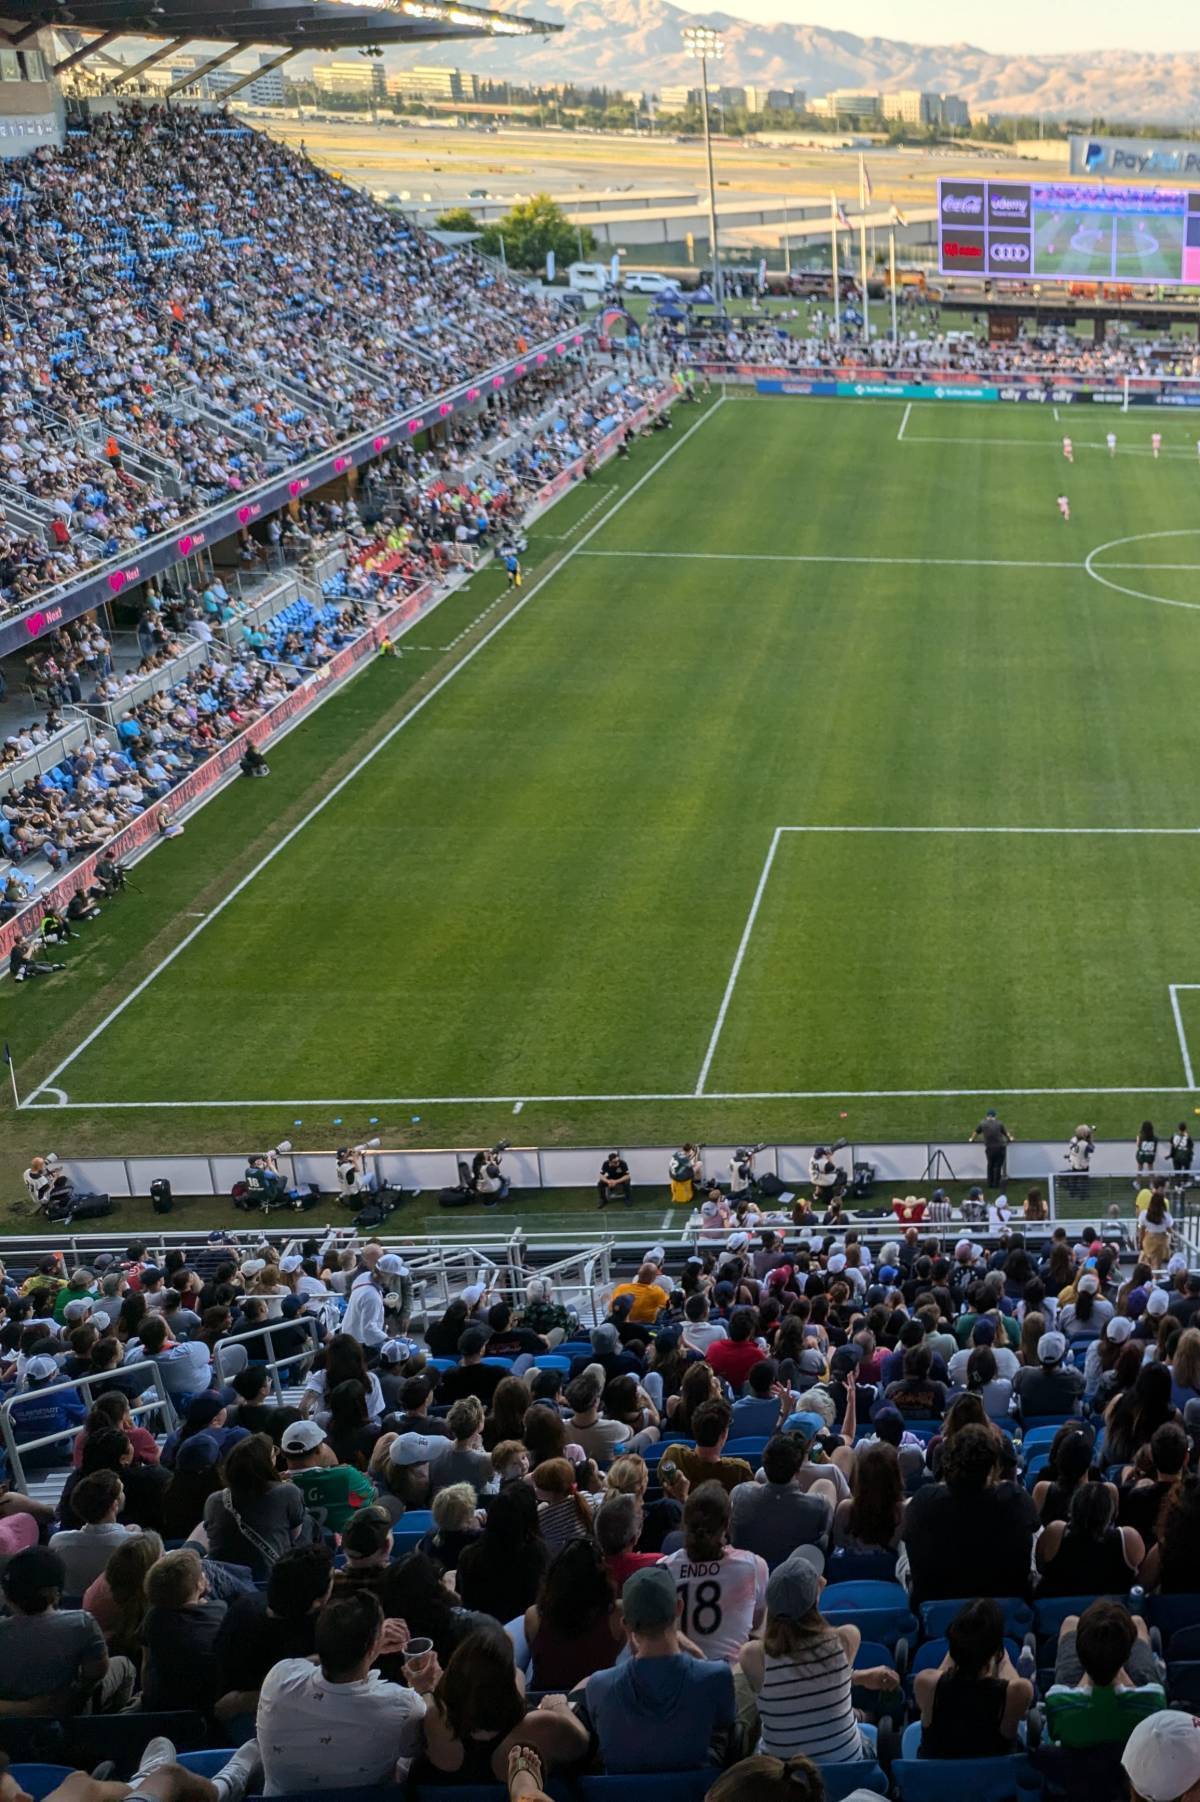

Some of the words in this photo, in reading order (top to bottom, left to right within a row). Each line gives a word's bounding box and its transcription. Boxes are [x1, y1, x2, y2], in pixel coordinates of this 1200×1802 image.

[125, 566, 141, 584] Next
[45, 605, 63, 625] Next
[680, 1562, 720, 1579] ENDO
[676, 1580, 722, 1635] 18
